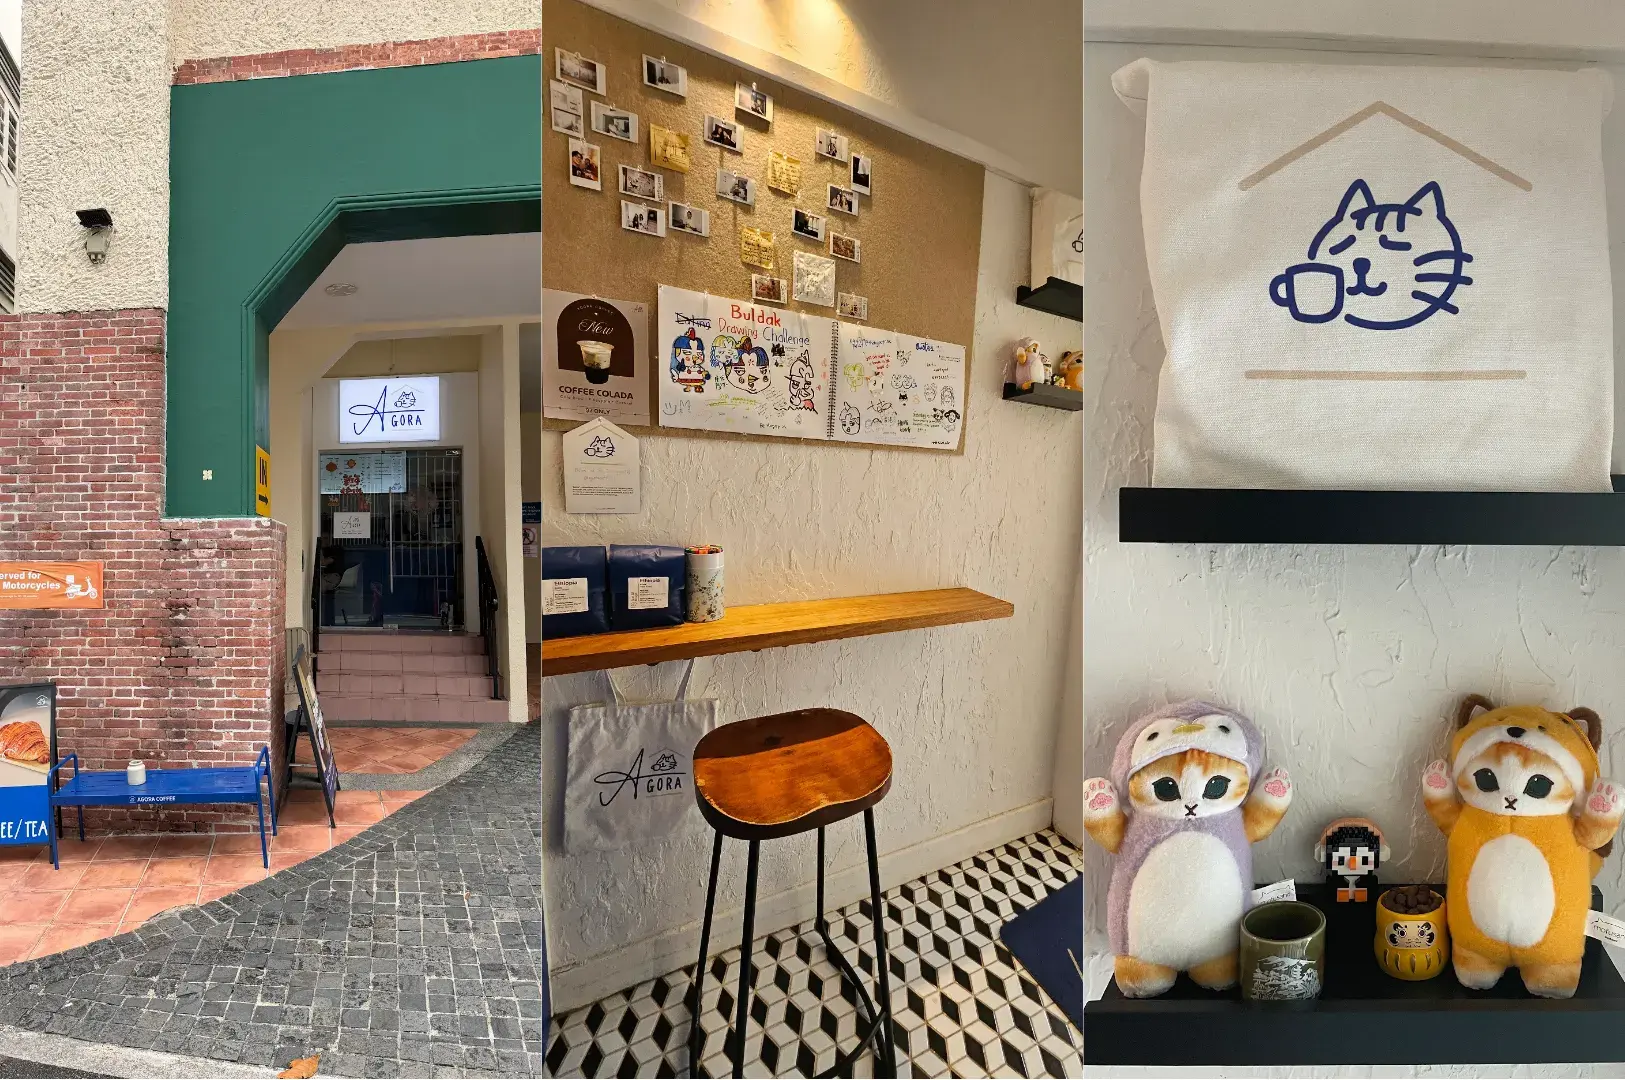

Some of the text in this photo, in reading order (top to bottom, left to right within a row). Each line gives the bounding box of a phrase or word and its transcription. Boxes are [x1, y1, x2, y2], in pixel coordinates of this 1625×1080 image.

[578, 318, 614, 336] New
[731, 304, 782, 328] Buldak
[718, 317, 811, 346] Drawing Challenge
[558, 385, 634, 400] COFFEE COLADA
[348, 384, 426, 436] AGORA
[259, 456, 268, 488] IN
[2, 581, 61, 592] Motorcycles
[27, 571, 41, 580] for
[593, 747, 687, 807] AGORA
